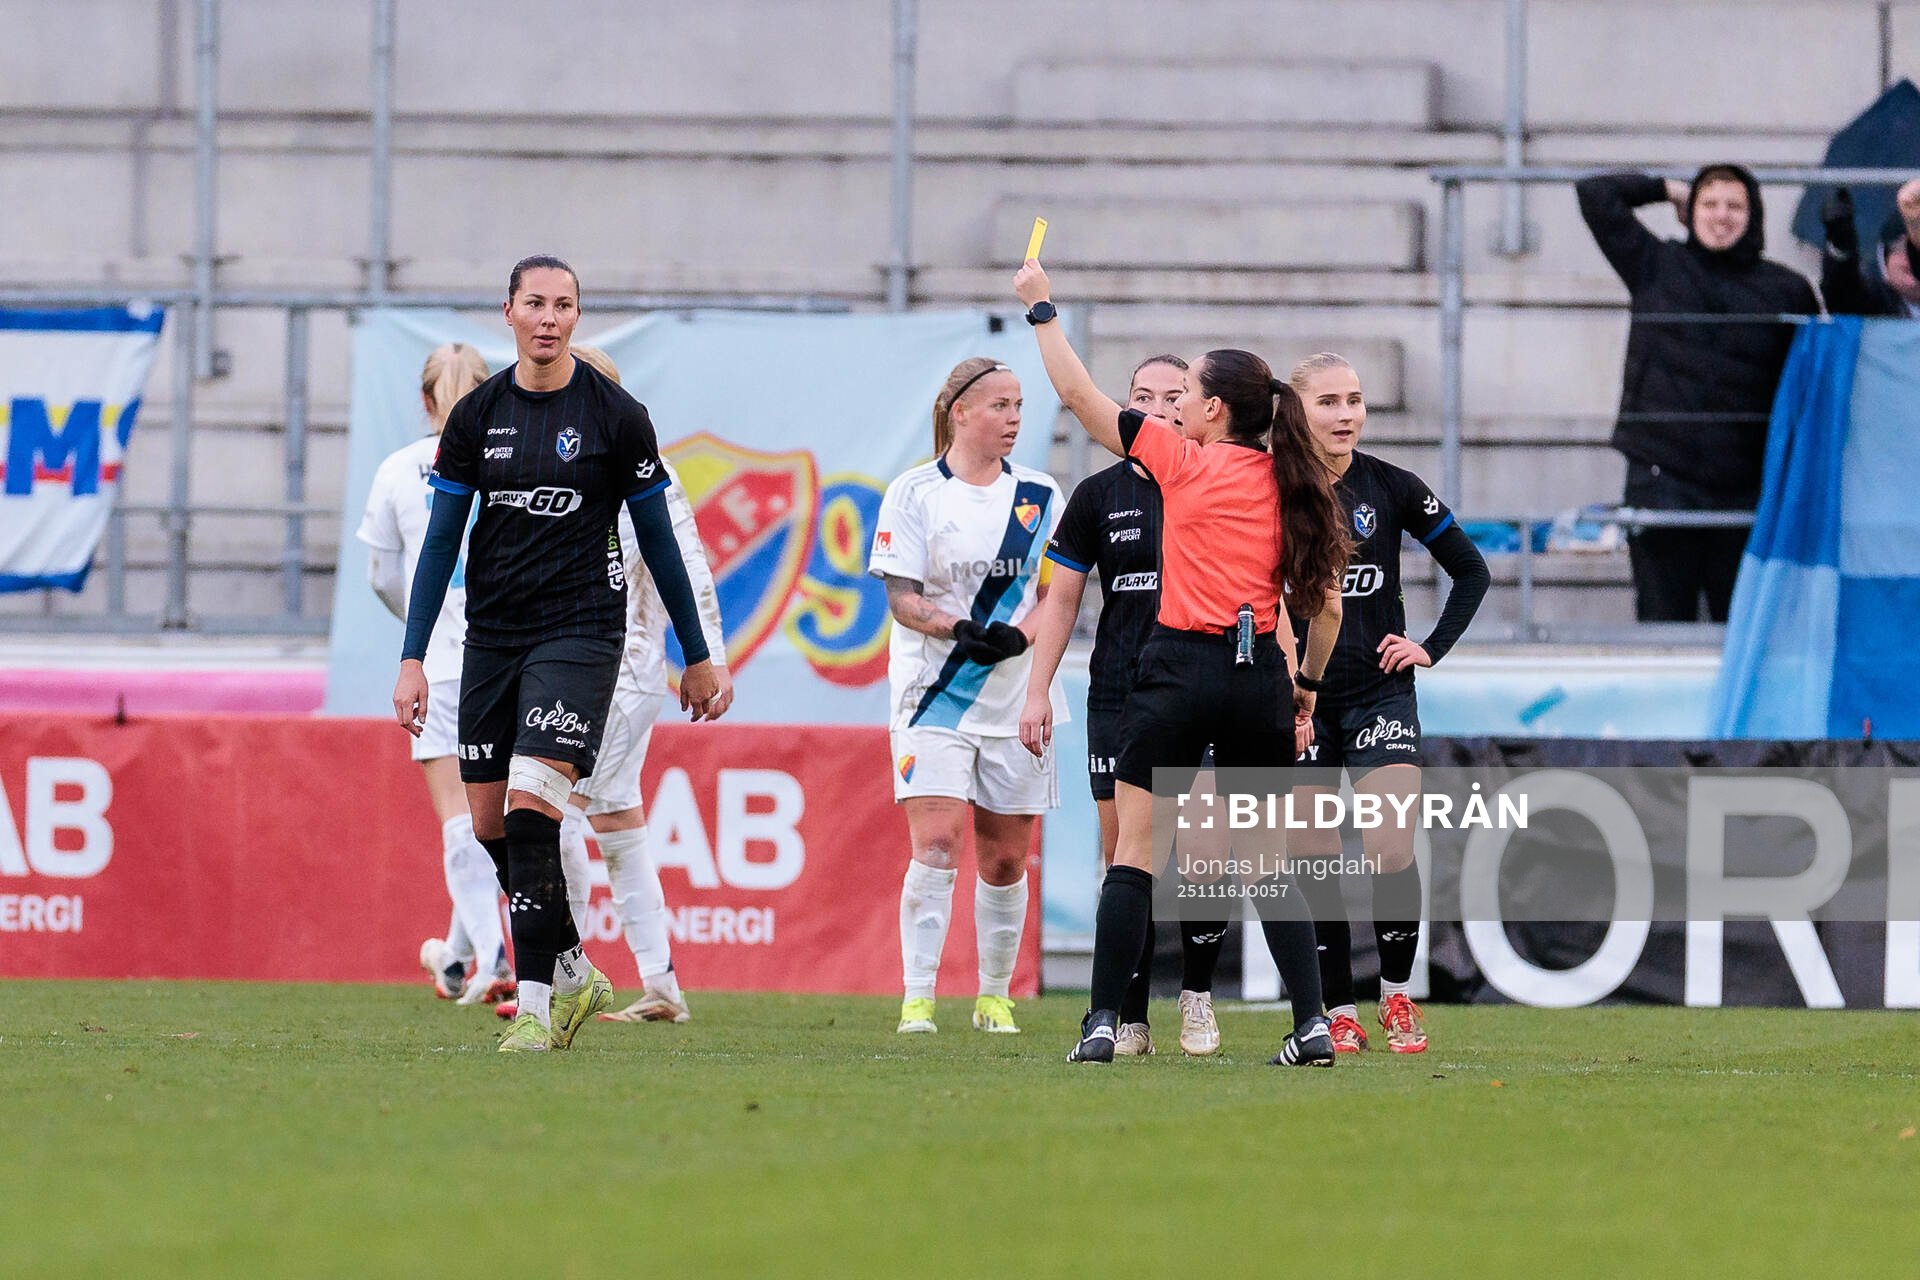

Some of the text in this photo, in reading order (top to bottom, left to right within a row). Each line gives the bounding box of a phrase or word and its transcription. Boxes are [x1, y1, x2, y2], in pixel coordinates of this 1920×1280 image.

[529, 489, 575, 514] GO
[1108, 510, 1135, 520] CRAFT
[555, 736, 580, 747] CRAFT
[586, 767, 805, 890] AB
[664, 905, 774, 944] NERGI
